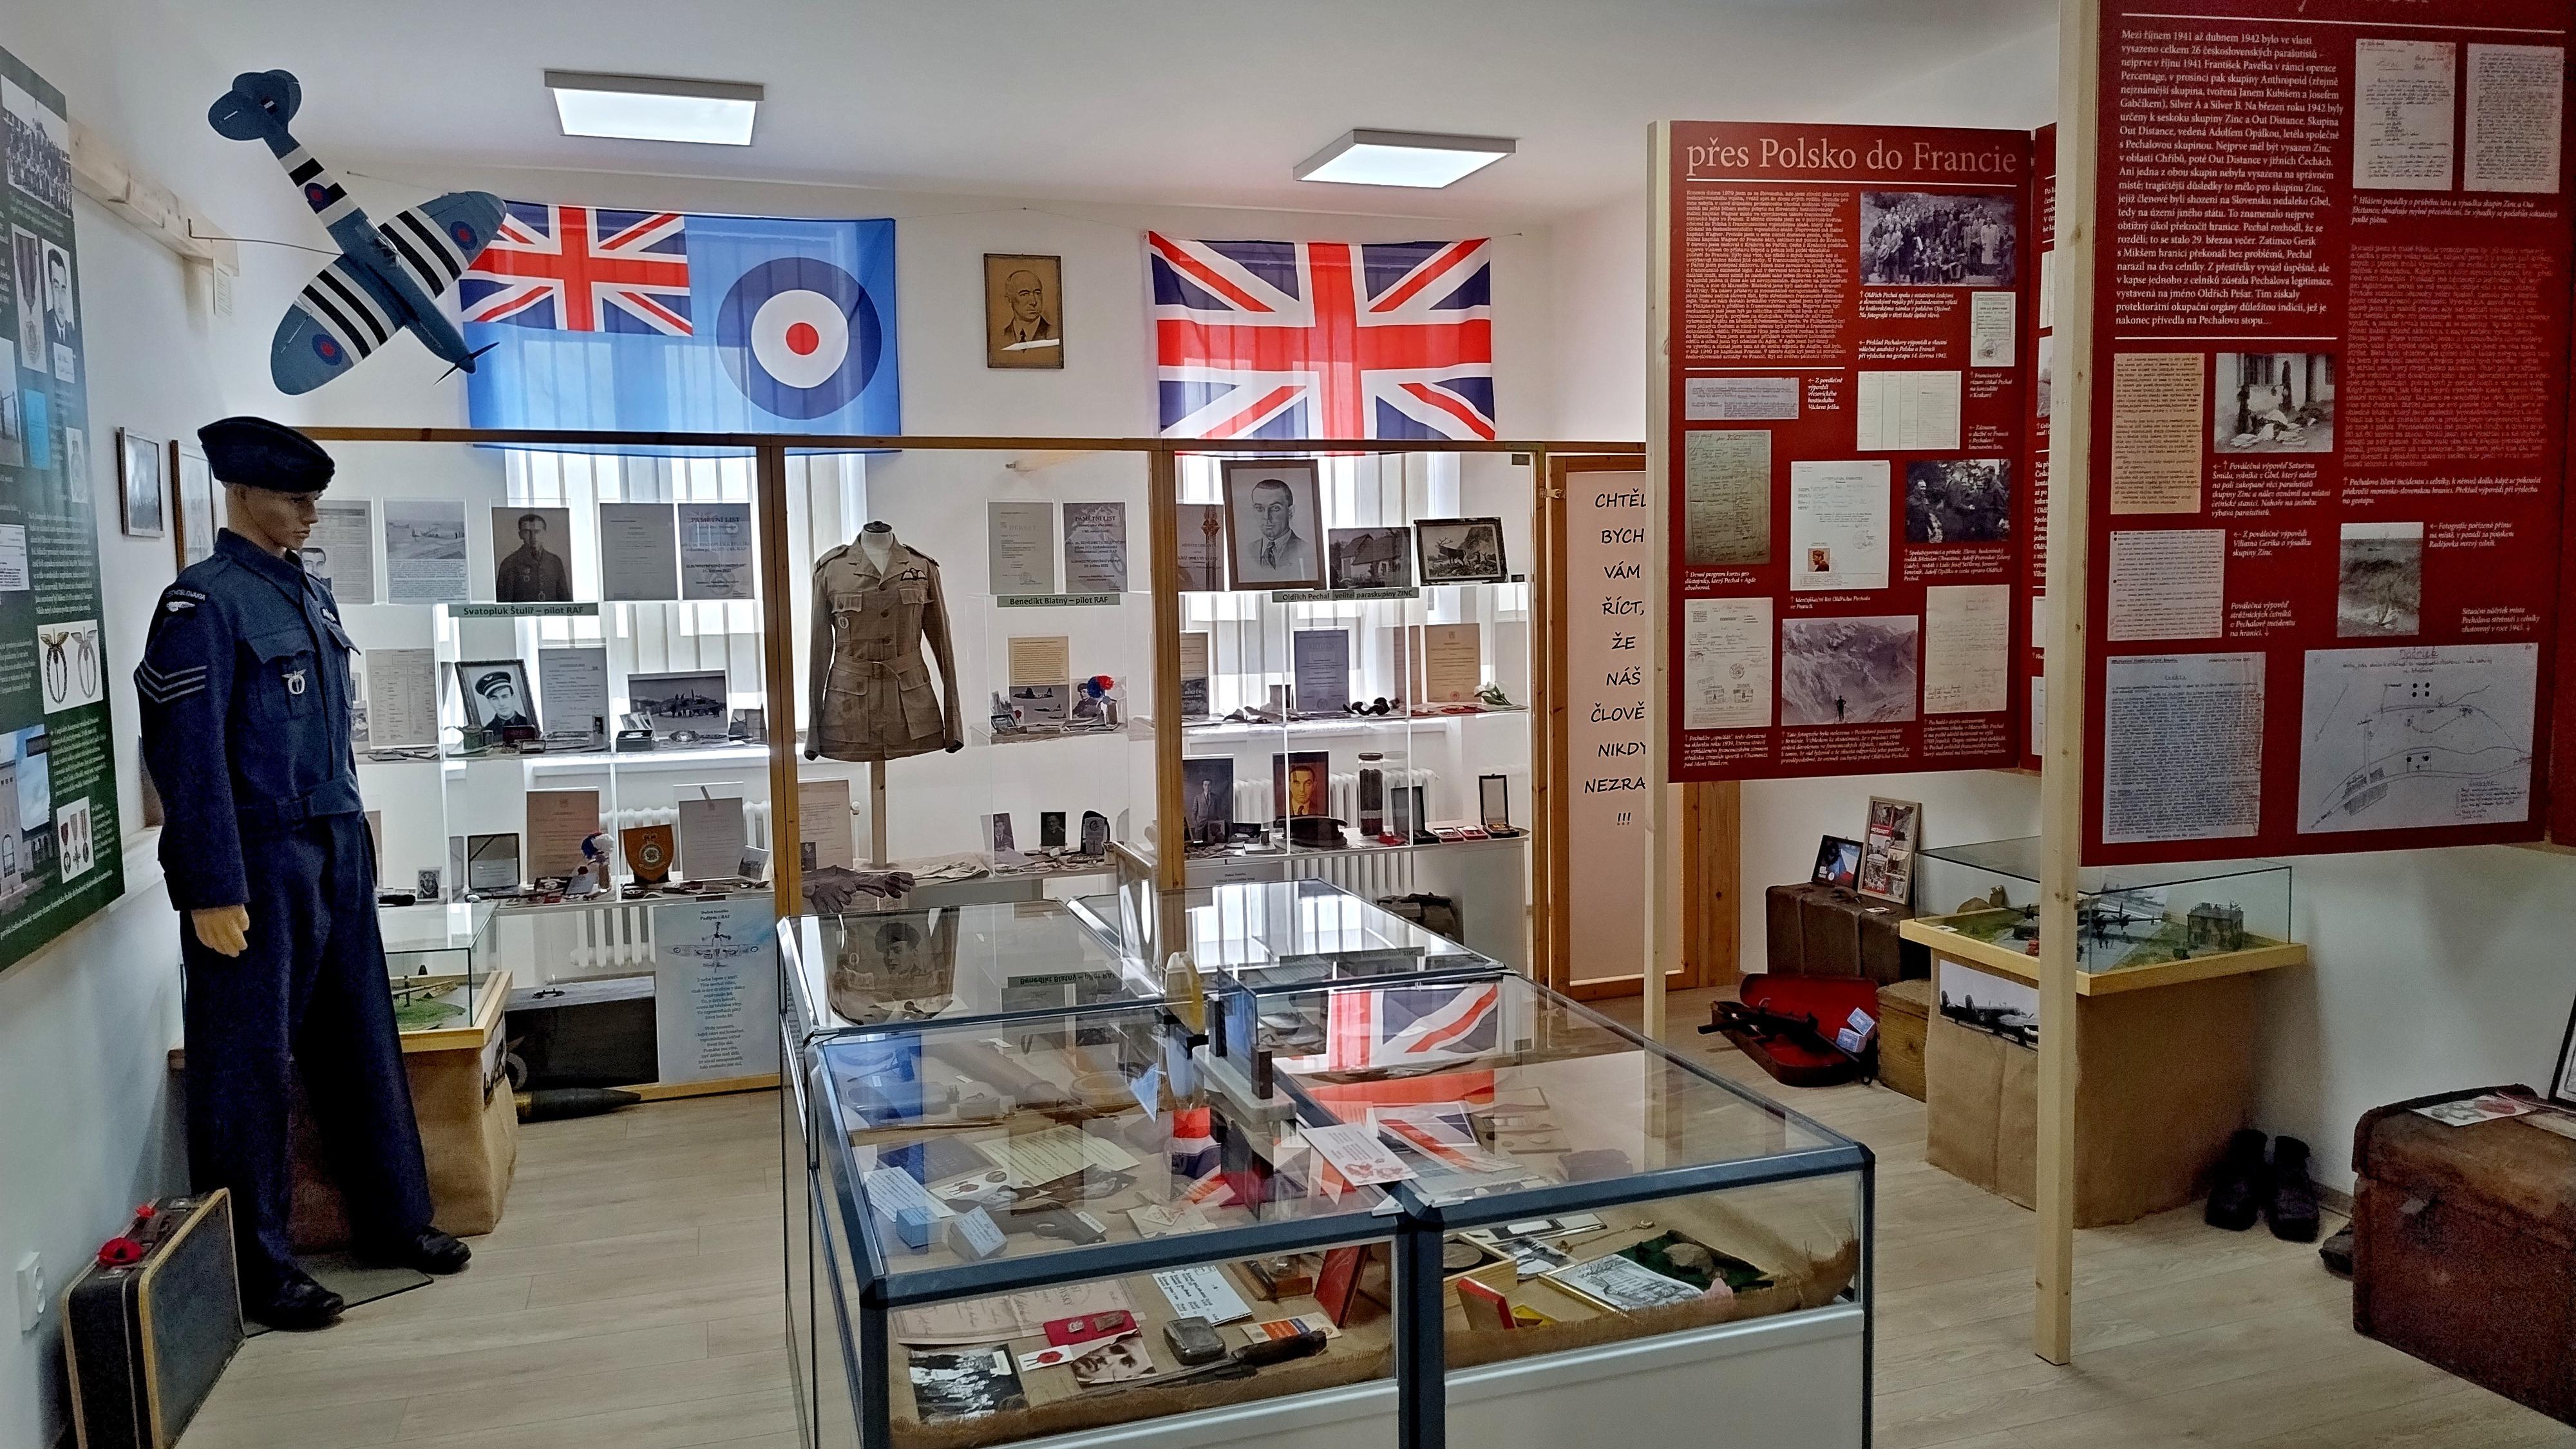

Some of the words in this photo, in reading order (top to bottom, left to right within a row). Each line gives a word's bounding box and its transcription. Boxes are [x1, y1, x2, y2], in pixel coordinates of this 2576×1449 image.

[2121, 28, 2142, 38] Mezi
[2144, 29, 2171, 42] říjnem
[2174, 30, 2192, 40] 1941
[2194, 31, 2203, 41] až
[2205, 32, 2239, 42] dubnem
[2241, 33, 2259, 43] 1942
[2261, 33, 2278, 46] bylo
[2291, 35, 2312, 44] vlasti
[2121, 45, 2158, 55] vysazeno
[2160, 44, 2189, 54] celkem
[2192, 45, 2201, 54] 26
[2202, 45, 2271, 59] československých
[2274, 48, 2317, 61] parašutistů
[2121, 56, 2151, 69] nejprve
[2161, 57, 2180, 70] říjnu
[2183, 58, 2201, 68] 1941
[2204, 59, 2240, 69] František
[2243, 61, 2273, 70] Pavelka
[2281, 62, 2304, 71] rámci
[2306, 65, 2336, 75] operace
[2175, 72, 2208, 84] prosinci
[2210, 73, 2225, 85] pak
[2227, 73, 2257, 86] skupiny
[2260, 75, 2307, 88] Anthropoid
[2308, 76, 2338, 88] (zřejmě
[2120, 84, 2168, 97] nejznámější
[2206, 86, 2237, 96] tvořená
[2239, 88, 2264, 97] Janem
[2266, 88, 2300, 98] Kubišem
[2309, 90, 2339, 99] Josefem
[2170, 99, 2192, 108] Silver
[2195, 99, 2201, 108] A
[2210, 100, 2232, 109] Silver
[2245, 100, 2256, 110] Na
[2258, 101, 2284, 111] březen
[2286, 102, 2305, 111] roku
[2307, 102, 2325, 112] 1942
[2327, 103, 2343, 115] byly
[2119, 111, 2146, 124] určeny
[2149, 112, 2155, 121] k
[2157, 112, 2189, 122] seskoku
[2191, 113, 2222, 126] skupiny
[2225, 114, 2242, 124] Zinc
[2251, 115, 2267, 124] Out
[2307, 117, 2338, 129] Skupina
[2119, 125, 2136, 134] Out
[2177, 126, 2206, 136] vedená
[2209, 127, 2242, 137] Adolfem
[2283, 129, 2304, 138] letěla
[2306, 129, 2339, 142] společně
[2125, 138, 2172, 149] Pechalovou
[2215, 140, 2247, 153] Nejprve
[2249, 142, 2264, 151] měl
[2266, 142, 2278, 153] být
[2280, 144, 2311, 155] vysazen
[2313, 143, 2330, 152] Zinc
[1687, 137, 1749, 175] přes
[1759, 138, 1856, 169] Polsko
[1867, 139, 1902, 169] do
[1913, 142, 2016, 173] Francie
[2125, 152, 2153, 162] oblasti
[2188, 153, 2206, 166] poté
[2208, 154, 2224, 164] Out
[2226, 155, 2260, 164] Distance
[2269, 155, 2296, 167] jižních
[1595, 488, 1646, 507] CHTĚL
[1601, 527, 1645, 544] BYCH
[2249, 530, 2279, 540] poválečné
[2280, 529, 2307, 540] výpovědi
[2233, 549, 2257, 558] skupiny
[1604, 560, 1640, 579] VÁM
[1045, 597, 1068, 605] Blatný
[1075, 596, 1092, 605] pilot
[1283, 592, 1307, 601] Oldřich
[1356, 591, 1396, 599] paraskupiny
[464, 607, 508, 616] Svatopluk
[510, 605, 535, 615] Štulíř
[544, 607, 564, 616] pilot
[1602, 596, 1645, 616] ŘÍCT,
[2263, 600, 2289, 611] výpověď
[2230, 611, 2268, 620] strážnických
[1611, 632, 1636, 650] ŽE
[1606, 666, 1641, 686] NÁŠ
[1591, 701, 1645, 723] ČLOVĚ
[1598, 742, 1646, 757] NIKDY
[1584, 776, 1646, 793] NEZRA
[1617, 812, 1631, 825] !!!
